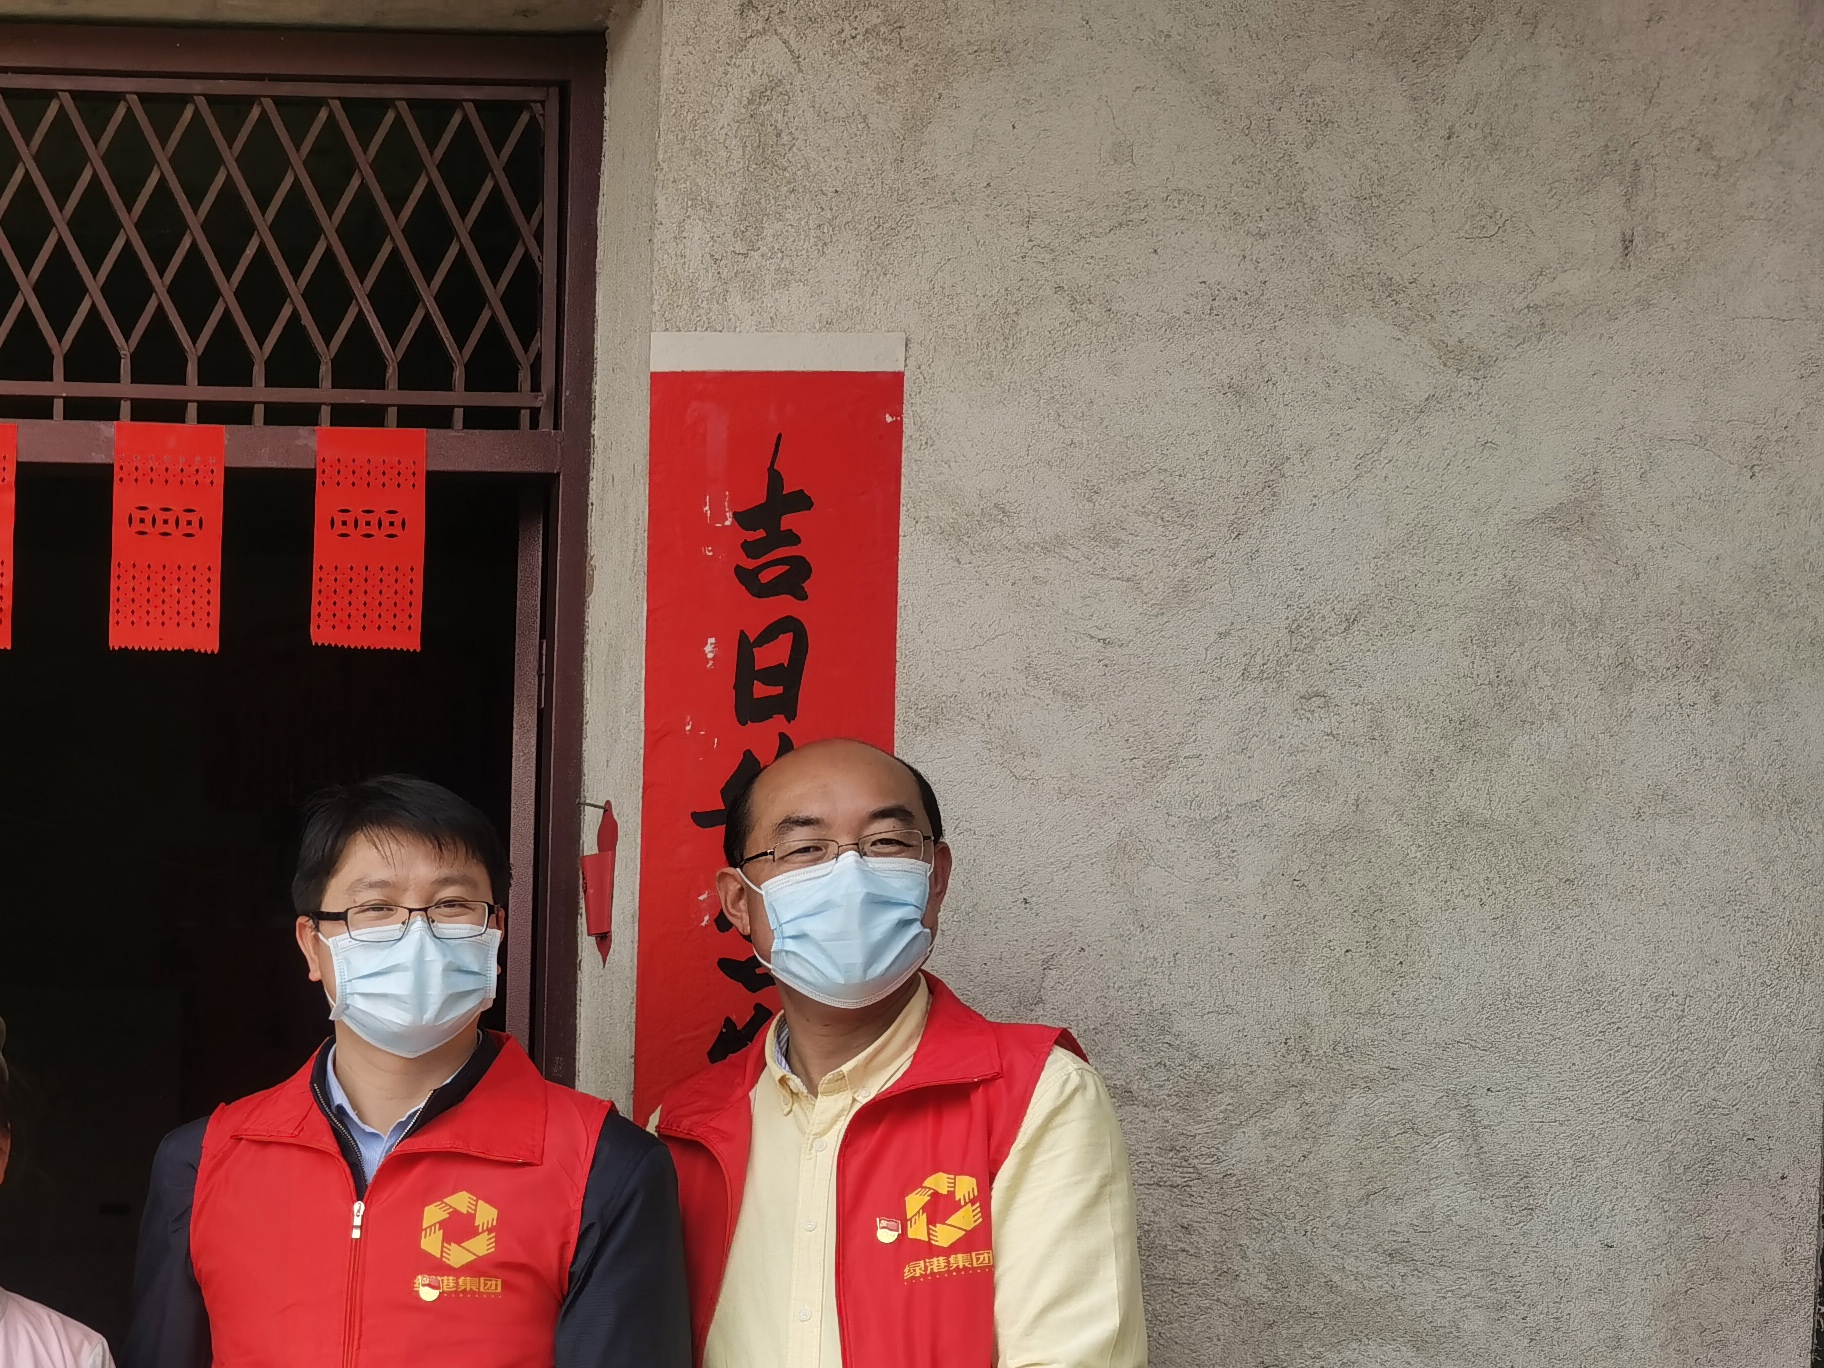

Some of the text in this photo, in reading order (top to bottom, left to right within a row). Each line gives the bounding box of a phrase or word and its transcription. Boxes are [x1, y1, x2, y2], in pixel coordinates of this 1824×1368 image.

[903, 1250, 994, 1280] 绿港集团
[413, 1274, 503, 1293] 港集团
